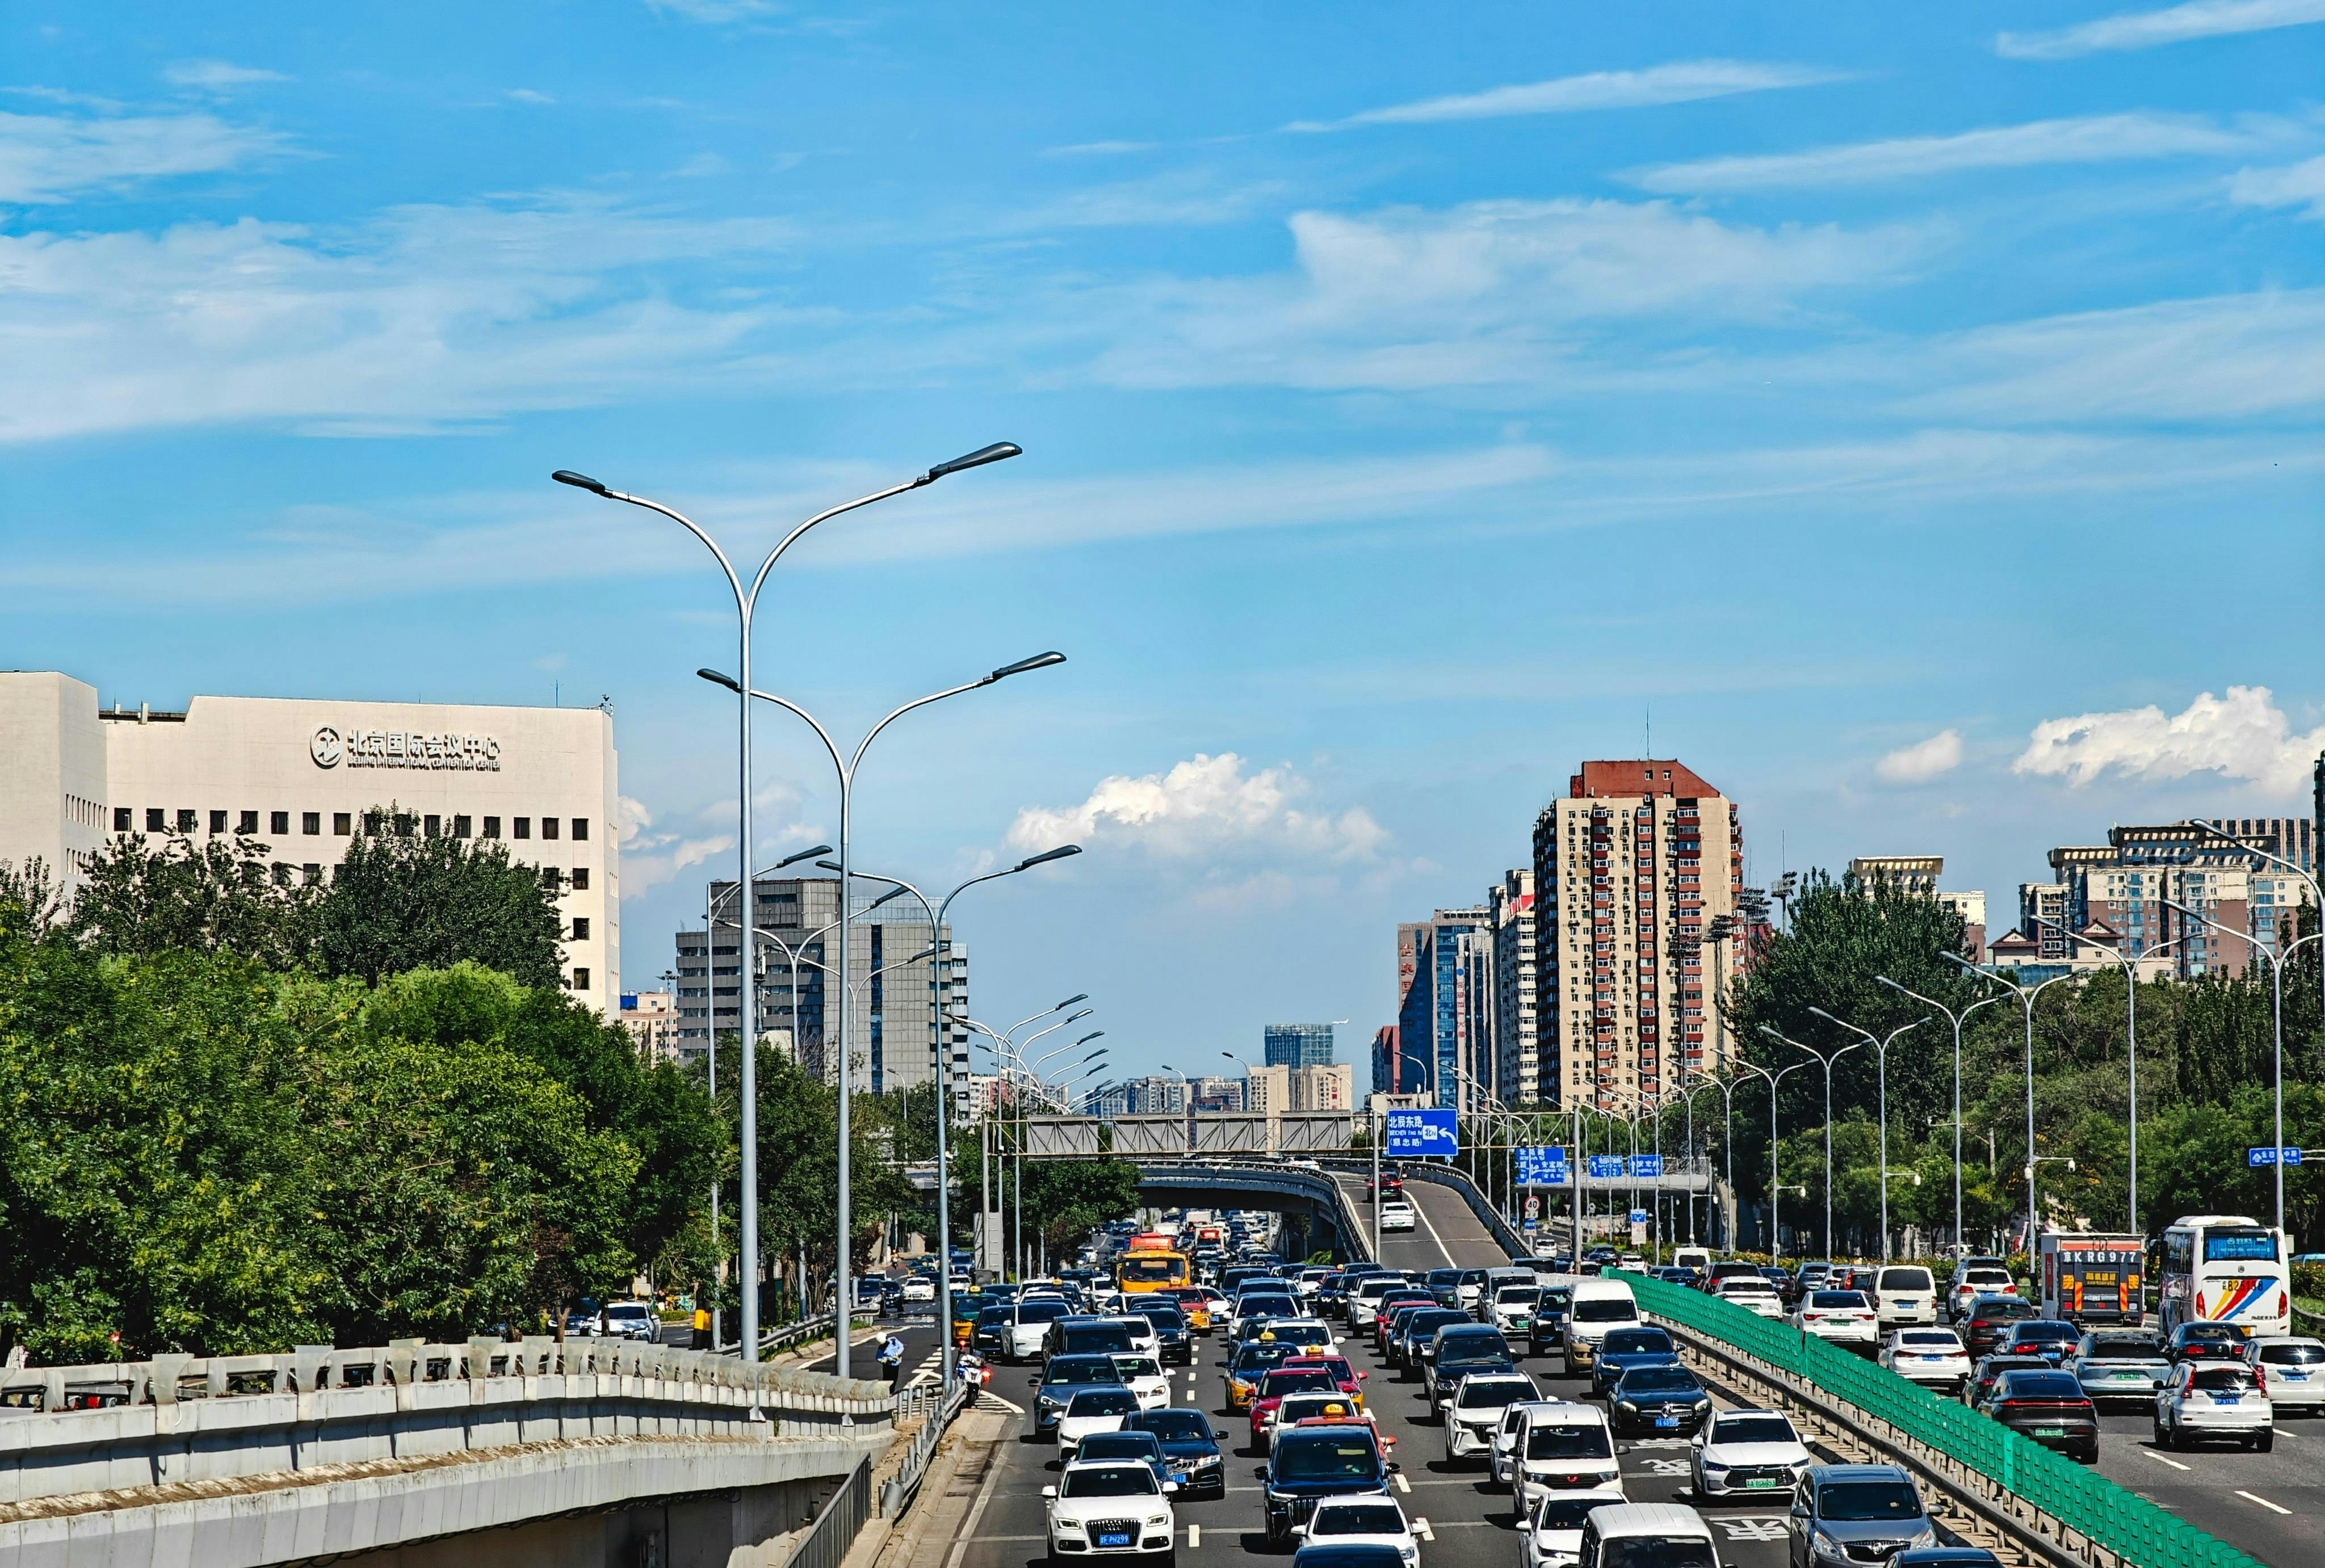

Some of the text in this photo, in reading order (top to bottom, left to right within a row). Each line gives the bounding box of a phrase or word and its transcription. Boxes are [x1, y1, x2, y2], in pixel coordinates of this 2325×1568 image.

[347, 729, 500, 760] 北京国际会议中心
[347, 756, 500, 772] BEIJING INTERNATIONAL CONVENTION CENTER
[1389, 1115, 1422, 1128] 北辰东路
[2261, 1150, 2297, 1158] 北四中路
